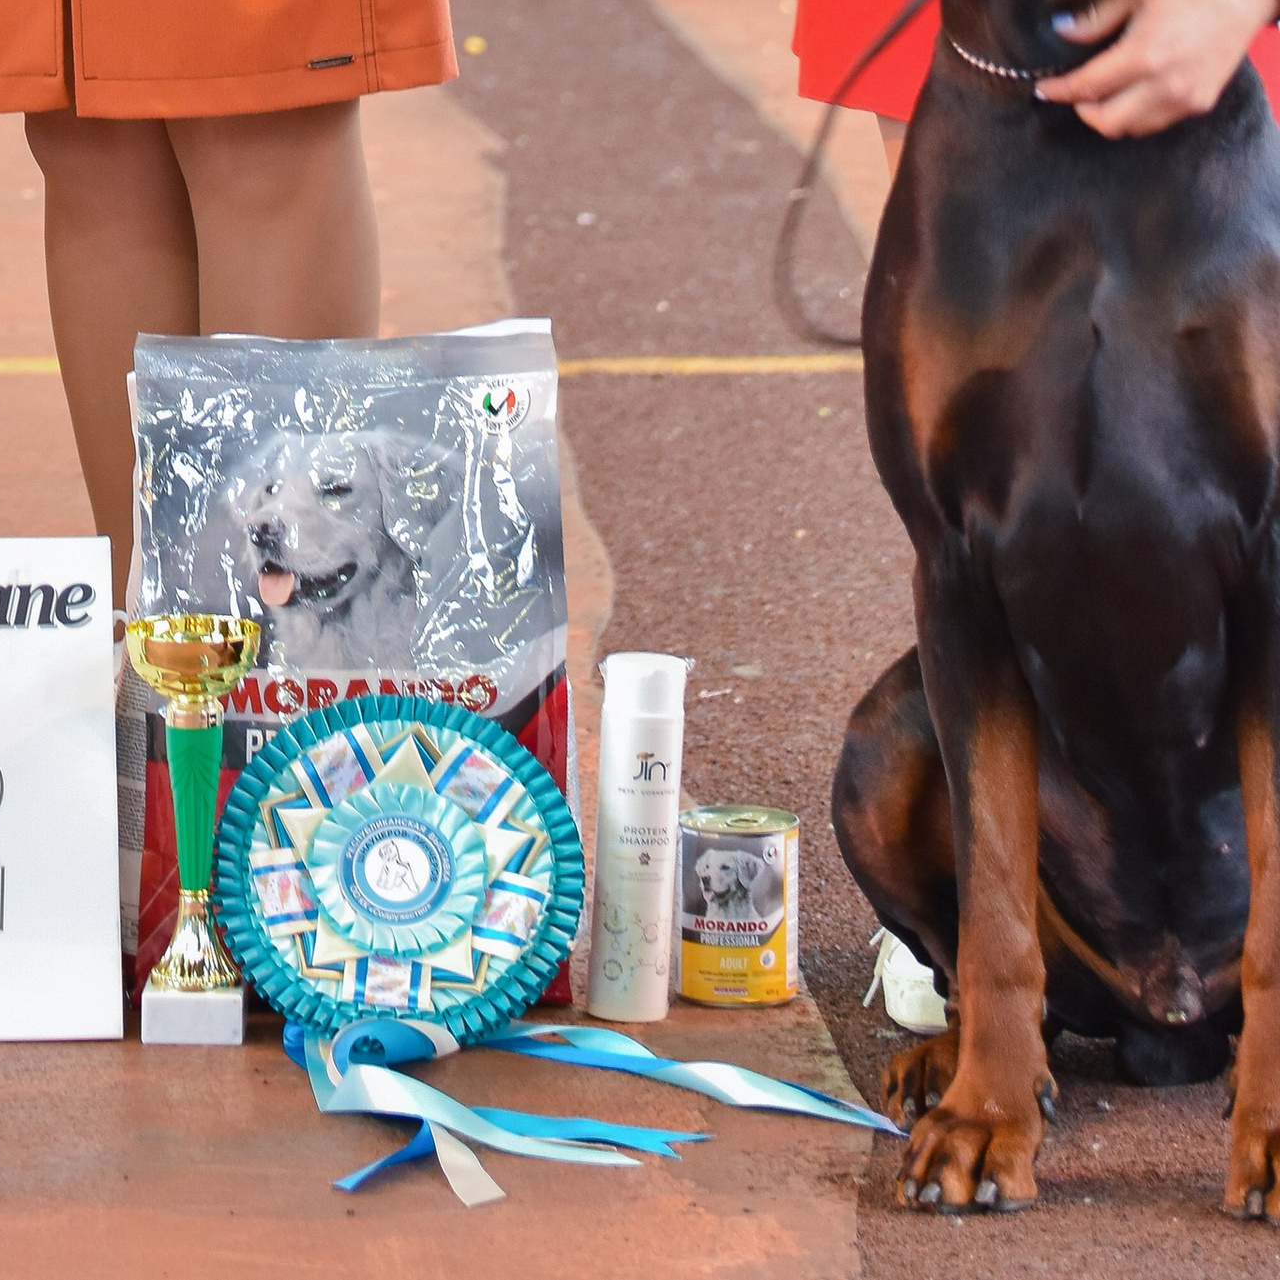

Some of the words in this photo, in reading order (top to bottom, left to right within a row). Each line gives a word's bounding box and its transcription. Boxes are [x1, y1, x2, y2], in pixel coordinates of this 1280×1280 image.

[623, 826, 668, 836] PROTEIN
[619, 836, 670, 847] SHAMPOO
[694, 917, 769, 933] MORANDO
[700, 932, 760, 947] PROFESSIONAL
[721, 956, 748, 970] ADULT
